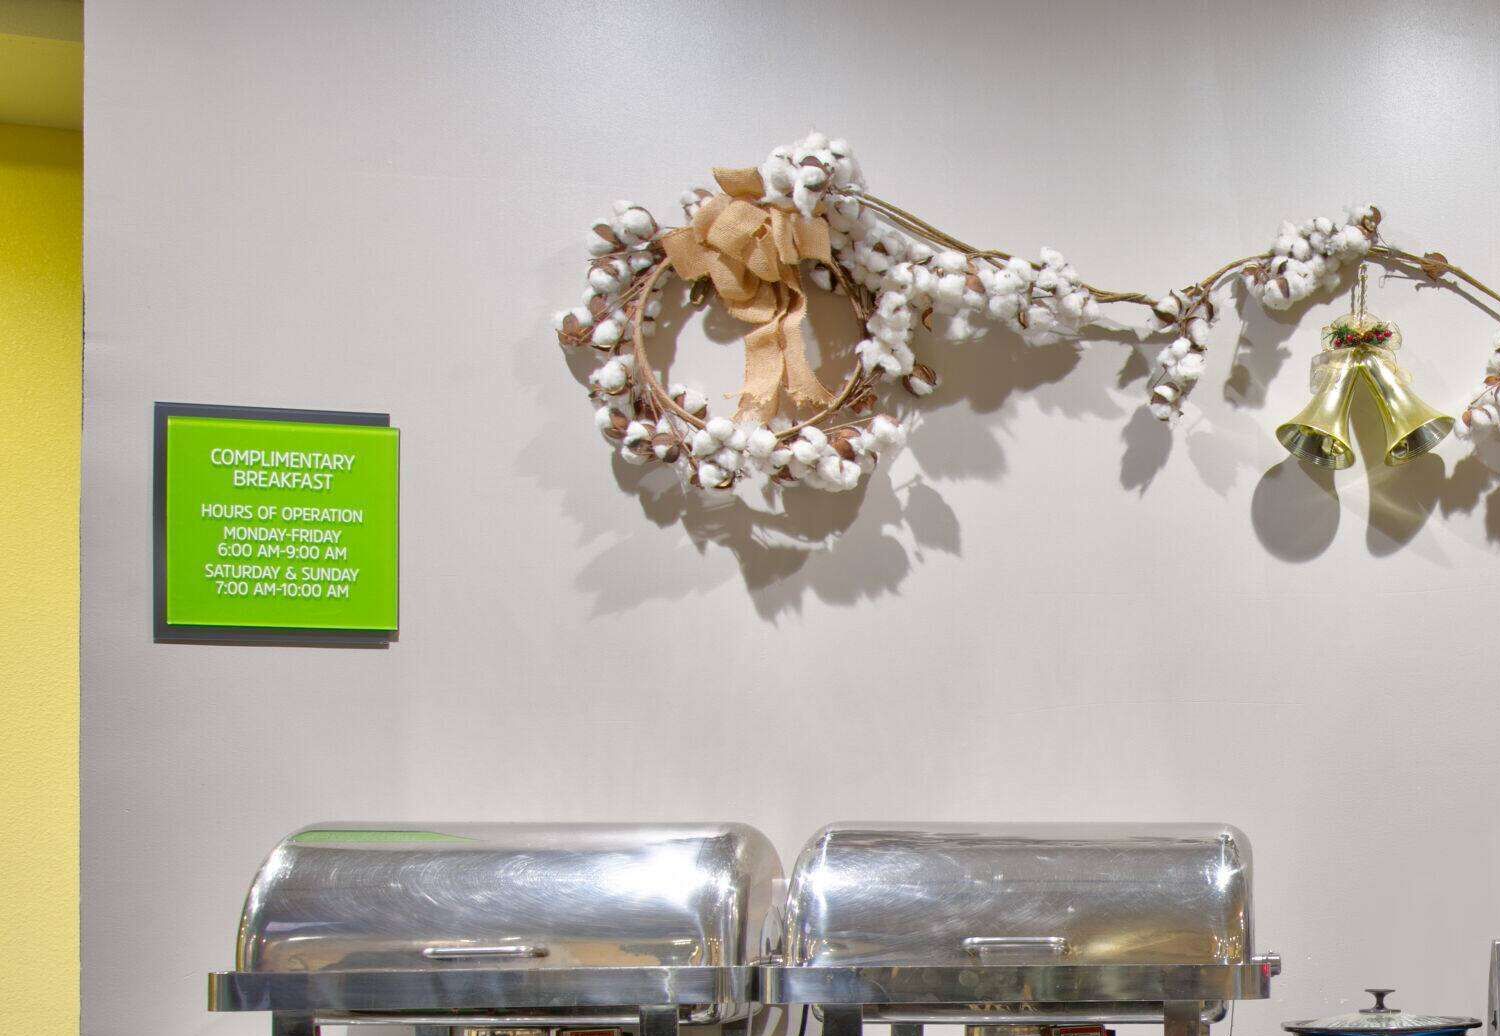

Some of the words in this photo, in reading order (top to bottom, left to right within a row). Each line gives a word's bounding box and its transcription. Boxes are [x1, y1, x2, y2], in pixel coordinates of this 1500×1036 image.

[211, 448, 355, 471] COMPLIMENTARY
[233, 471, 334, 490] BREAKFAST
[201, 504, 253, 519] HOURS
[258, 506, 277, 520] OF
[282, 507, 363, 523] OPERATION
[223, 527, 342, 543] MONDAY-FRIDAY
[218, 543, 252, 557] 6:00
[257, 544, 320, 559] AM-9:00
[324, 546, 347, 560] AM
[205, 564, 280, 579] SATURDAY
[286, 566, 297, 580] &
[301, 567, 359, 582] SUNDAY
[215, 581, 248, 595] 7:00
[253, 581, 322, 597] AM-10:00
[327, 584, 349, 598] AM
